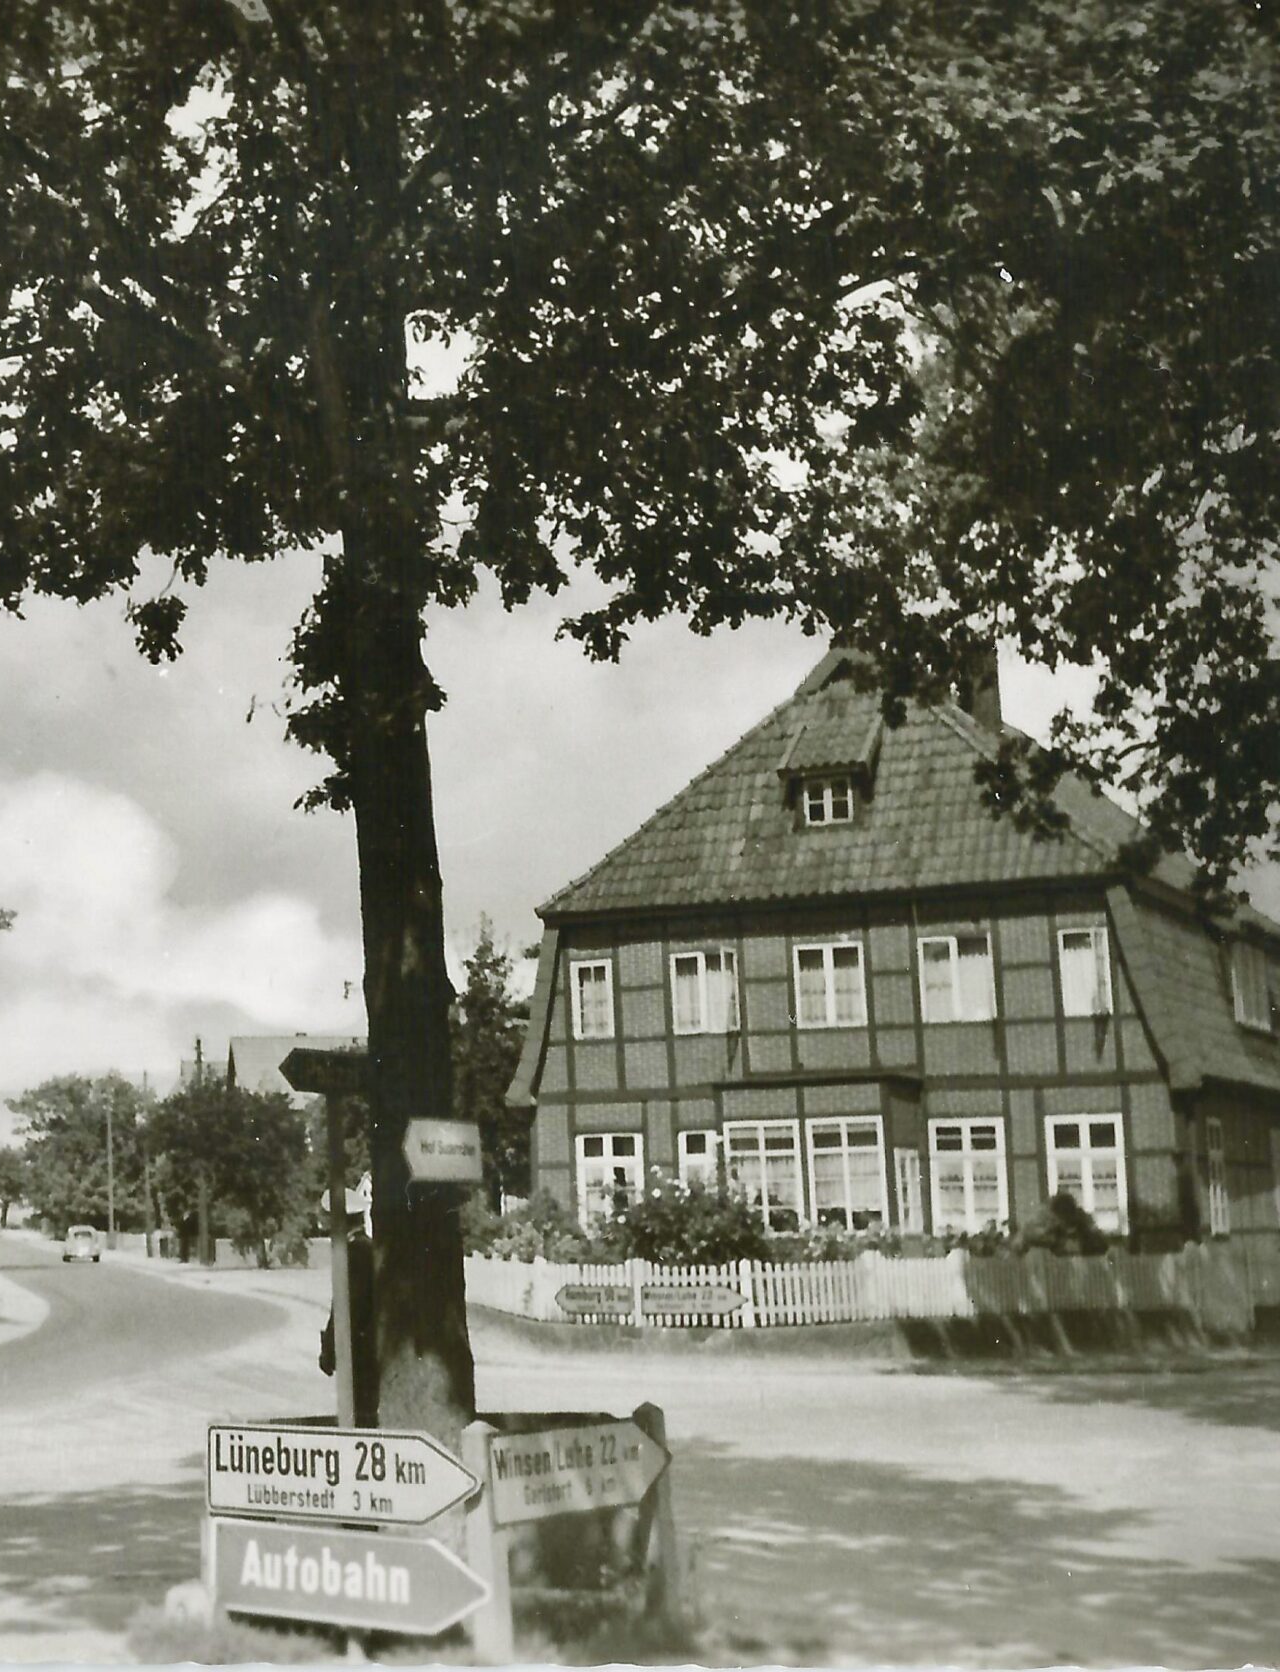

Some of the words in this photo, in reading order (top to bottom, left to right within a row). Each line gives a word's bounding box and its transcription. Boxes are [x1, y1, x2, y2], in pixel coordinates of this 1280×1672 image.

[214, 1433, 340, 1487] Lüneburg
[354, 1441, 387, 1482] 28
[394, 1452, 426, 1485] km
[246, 1483, 336, 1509] Lübberstedt
[352, 1490, 362, 1512] 3
[369, 1492, 394, 1514] km
[239, 1539, 411, 1606] Autobahn
